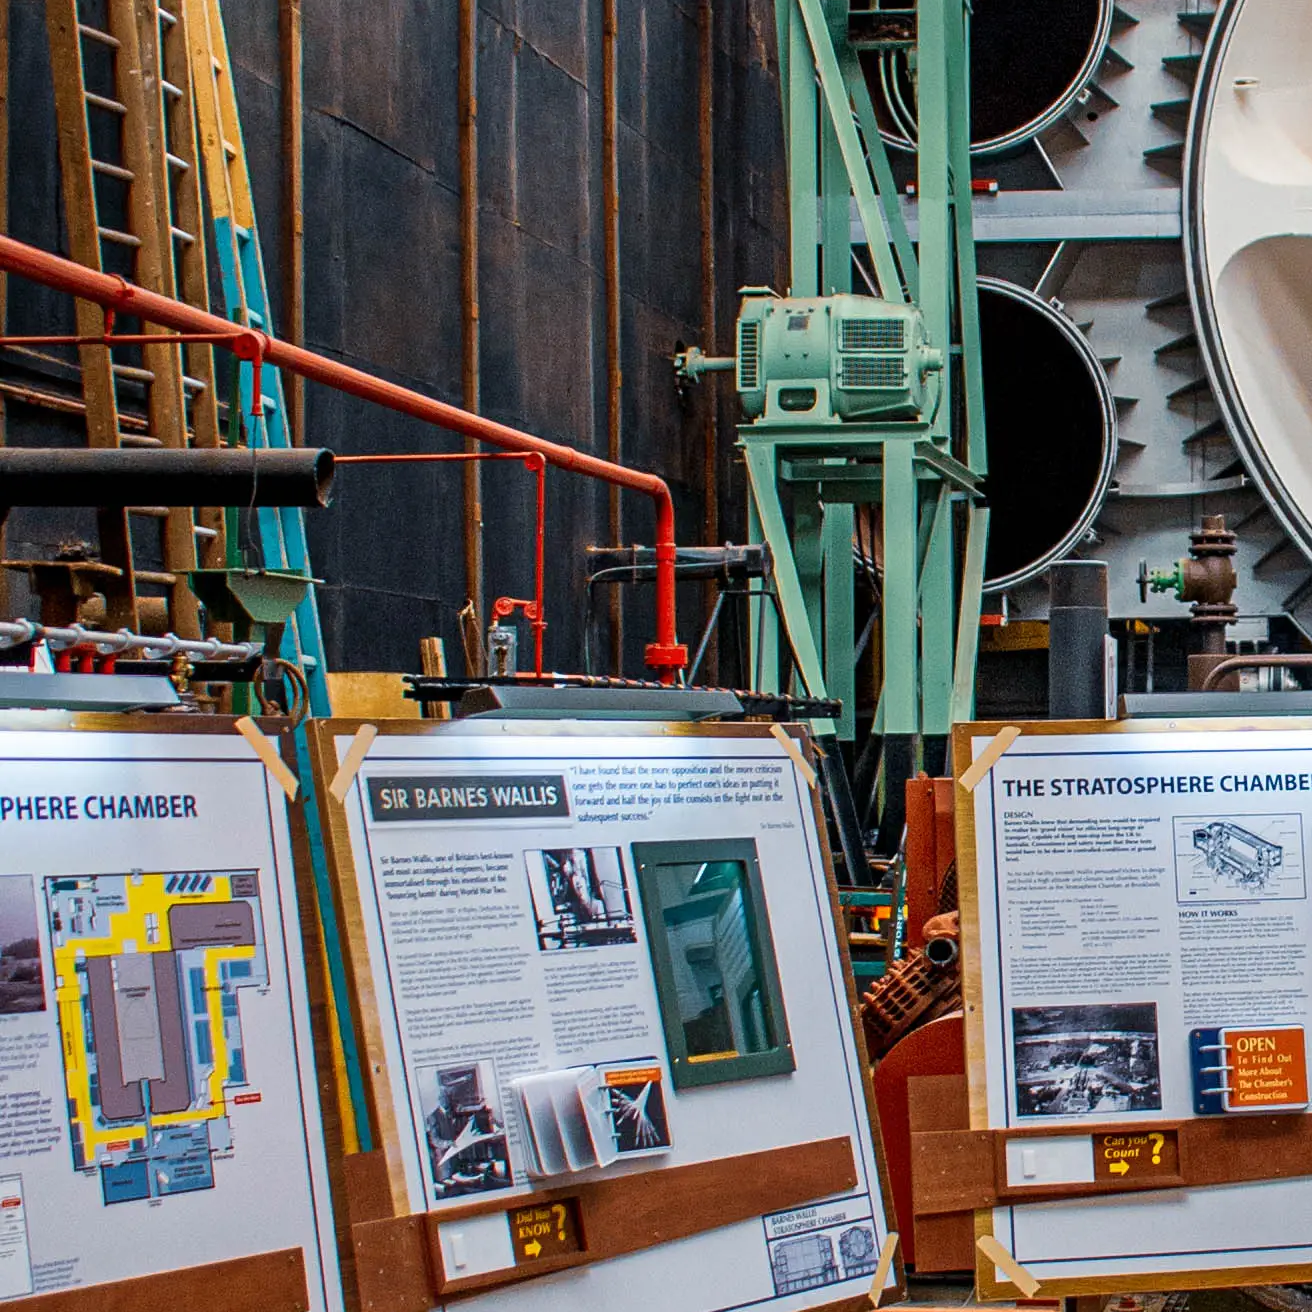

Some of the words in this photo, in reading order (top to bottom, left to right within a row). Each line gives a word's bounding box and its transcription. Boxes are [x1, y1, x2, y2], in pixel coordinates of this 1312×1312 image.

[579, 766, 596, 776] have
[598, 766, 620, 775] found
[621, 766, 636, 775] that
[637, 766, 650, 775] the
[651, 767, 670, 775] more
[671, 766, 708, 776] opposition
[709, 764, 723, 775] and
[723, 764, 735, 774] the
[754, 764, 783, 774] criticism
[572, 783, 587, 793] one
[588, 782, 604, 793] gets
[604, 780, 617, 792] the
[618, 783, 638, 791] more
[639, 782, 654, 790] one
[653, 780, 667, 790] has
[668, 780, 677, 789] to
[677, 779, 702, 792] perfect
[722, 779, 740, 788] ideas
[741, 778, 748, 788] in
[749, 779, 773, 791] putting
[774, 778, 779, 788] it
[1002, 779, 1045, 797] THE
[1050, 776, 1215, 796] STRATOSPHERE
[380, 788, 410, 809] SIR
[414, 787, 488, 808] BARNES
[491, 786, 558, 806] WALLIS
[575, 795, 605, 806] forward
[606, 795, 620, 806] and
[621, 794, 636, 805] half
[637, 794, 650, 805] the
[651, 794, 662, 807] joy
[663, 794, 672, 804] of
[673, 793, 685, 804] life
[685, 794, 713, 804] consists
[714, 793, 721, 803] in
[722, 793, 734, 803] the
[735, 792, 751, 805] fight
[751, 794, 763, 802] not
[764, 792, 772, 802] in
[772, 792, 784, 802] the
[84, 795, 198, 819] CHAMBER
[577, 812, 619, 824] subsequent
[1178, 911, 1199, 919] HOW
[1201, 910, 1208, 918] IT
[1236, 1037, 1276, 1052] OPEN
[1237, 1055, 1249, 1065] To
[1251, 1054, 1273, 1064] Find
[1276, 1054, 1292, 1064] Out
[1238, 1068, 1258, 1077] More
[1259, 1067, 1283, 1076] About
[1239, 1091, 1288, 1101] Construction
[1103, 1136, 1125, 1146] Can
[1128, 1137, 1147, 1147] you
[1104, 1148, 1140, 1159] Count
[1148, 1133, 1164, 1164] ?
[519, 1222, 551, 1238] KNOW
[552, 1204, 566, 1240] ?
